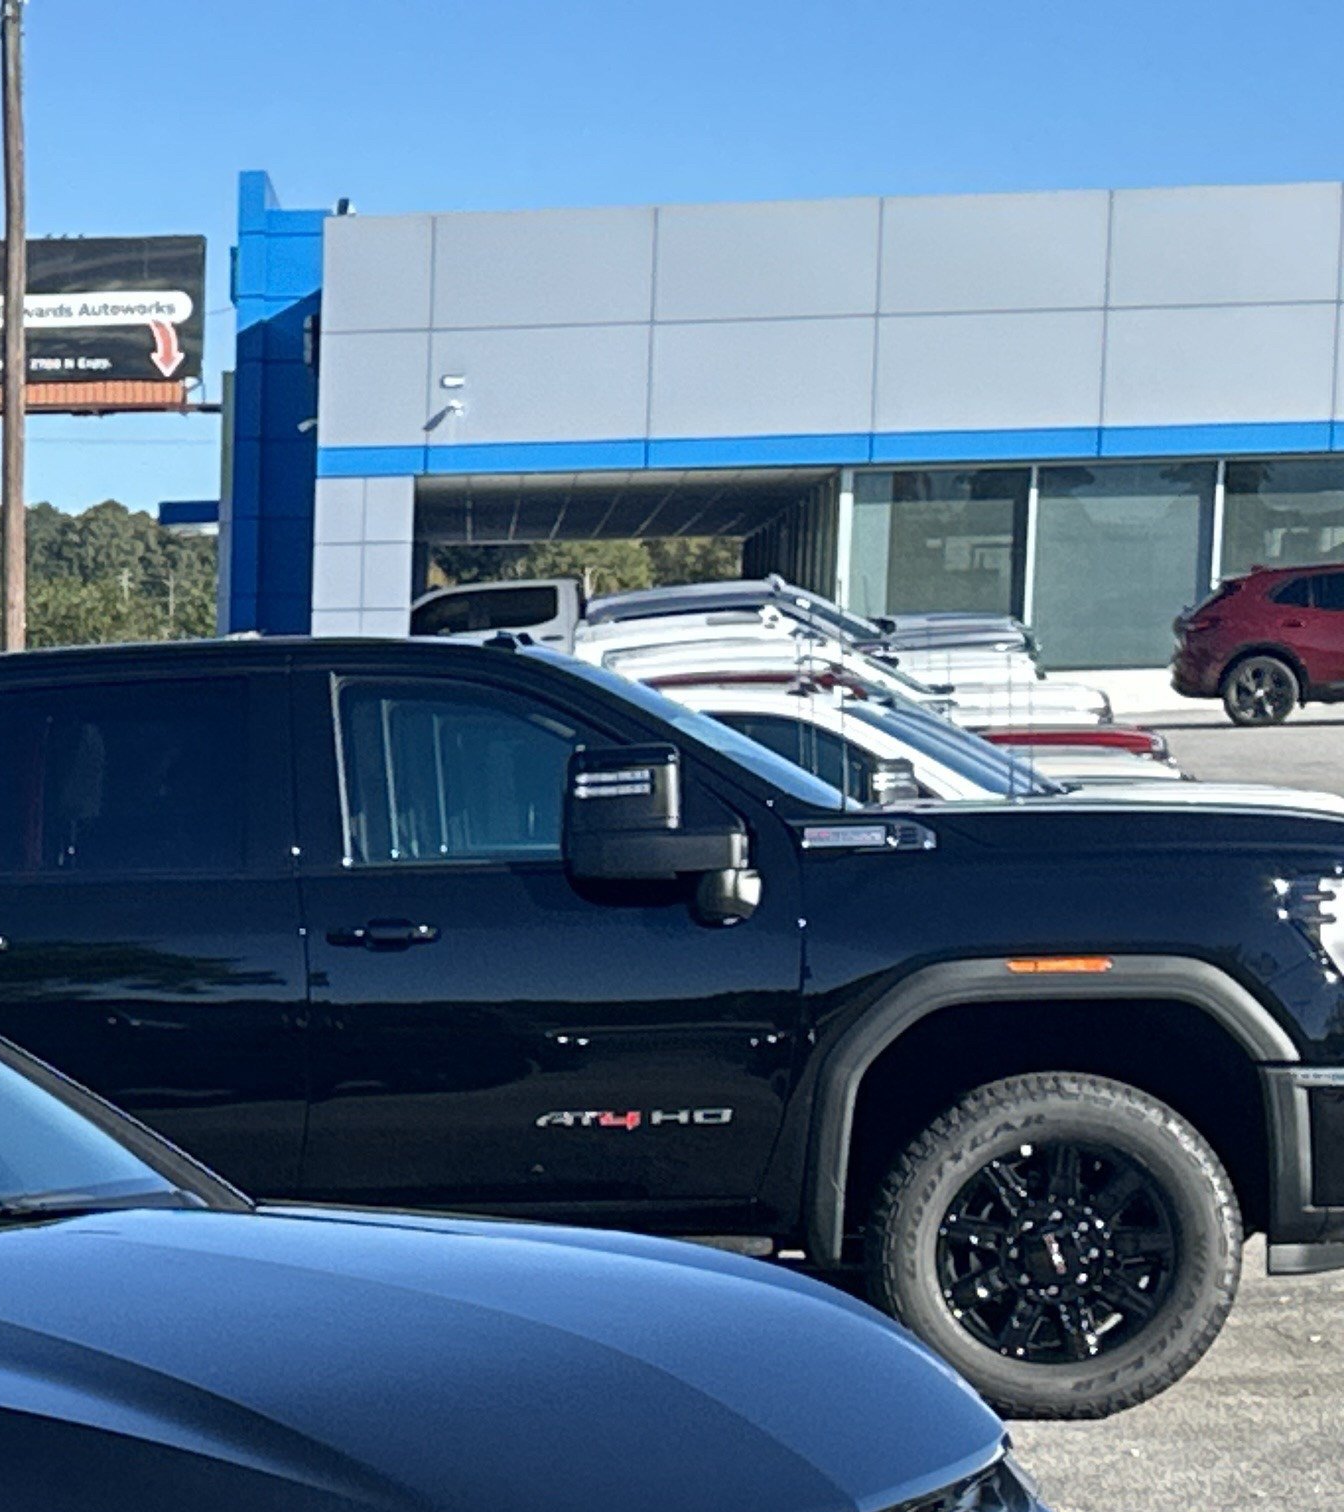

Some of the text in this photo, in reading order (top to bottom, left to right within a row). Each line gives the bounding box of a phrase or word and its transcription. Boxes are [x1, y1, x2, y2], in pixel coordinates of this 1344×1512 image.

[78, 301, 176, 317] Autoworks
[536, 1108, 733, 1130] AT4 HD
